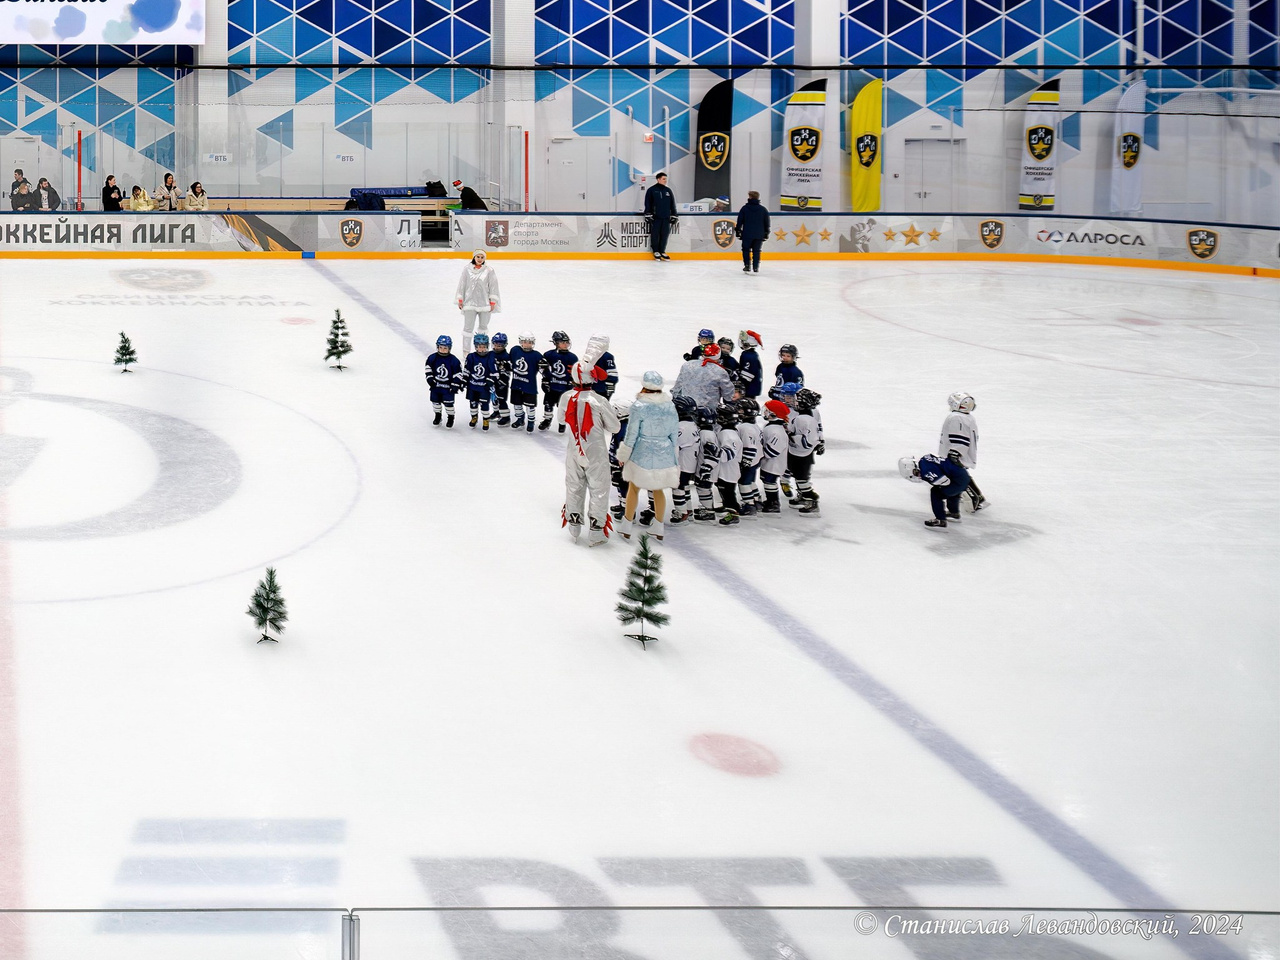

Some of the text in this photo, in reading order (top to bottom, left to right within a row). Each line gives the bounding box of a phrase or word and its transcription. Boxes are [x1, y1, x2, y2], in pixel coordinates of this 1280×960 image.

[513, 221, 563, 229] Департамент
[132, 222, 196, 244] ЛИГА
[1067, 231, 1146, 246] АЛРОСА
[541, 238, 570, 246] Москвы
[621, 235, 649, 248] СПОРТ
